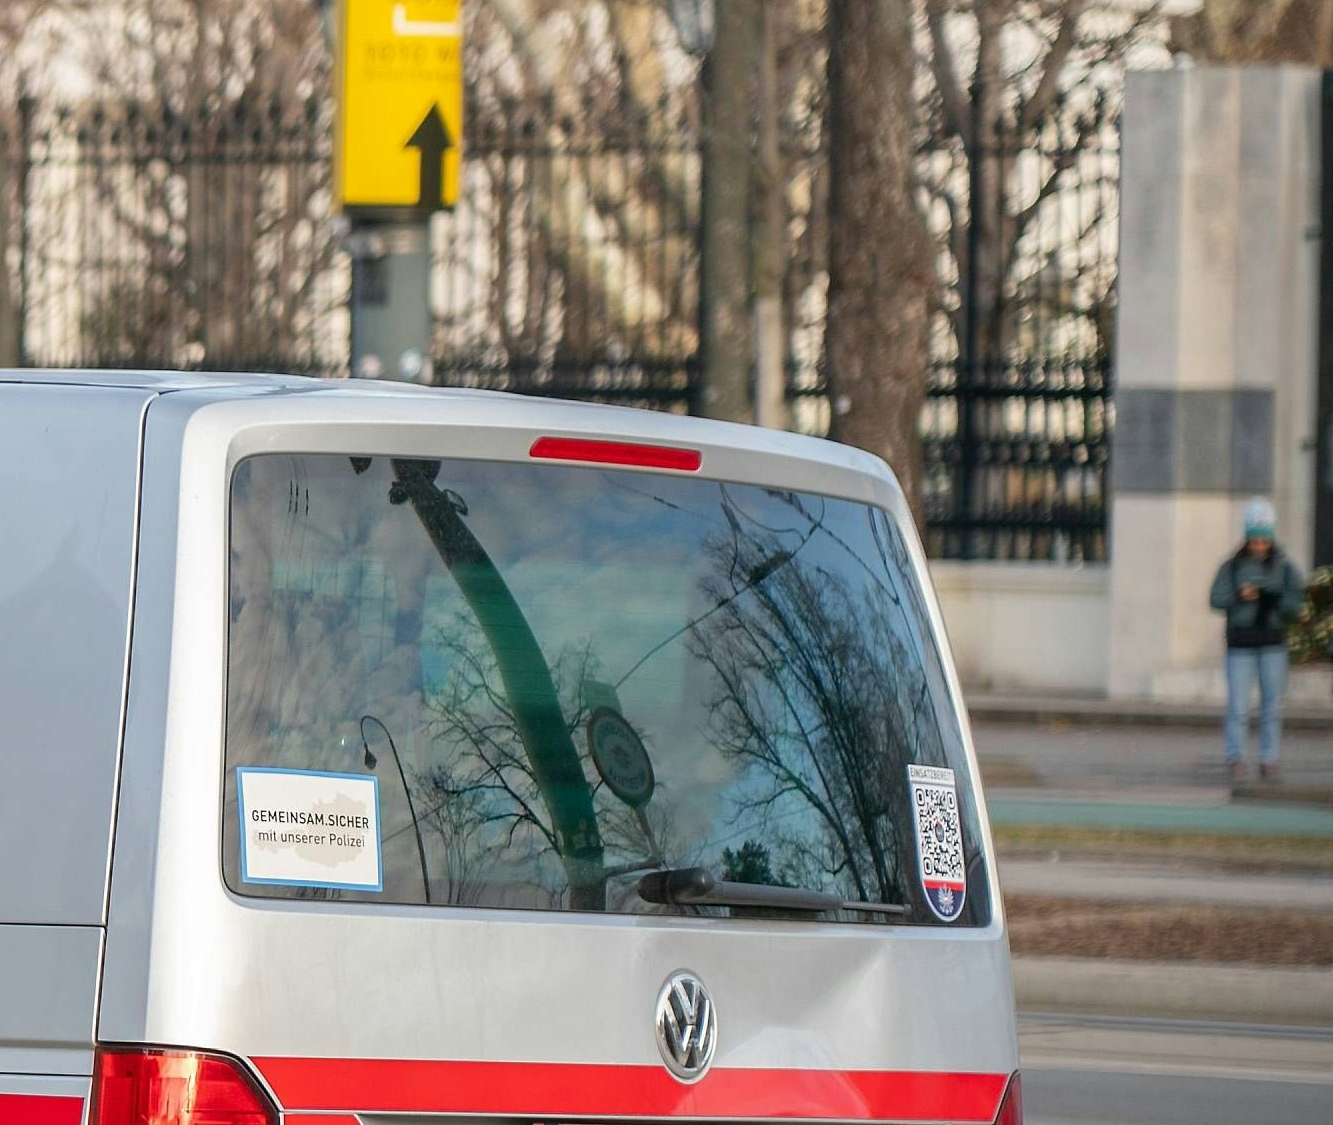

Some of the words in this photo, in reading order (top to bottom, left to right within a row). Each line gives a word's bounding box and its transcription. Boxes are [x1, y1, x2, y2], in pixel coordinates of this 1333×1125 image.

[251, 809, 370, 829] GEMEINSAM.SICHER
[258, 830, 278, 842] mit
[281, 832, 326, 845] unserer
[329, 833, 366, 848] Polizei
